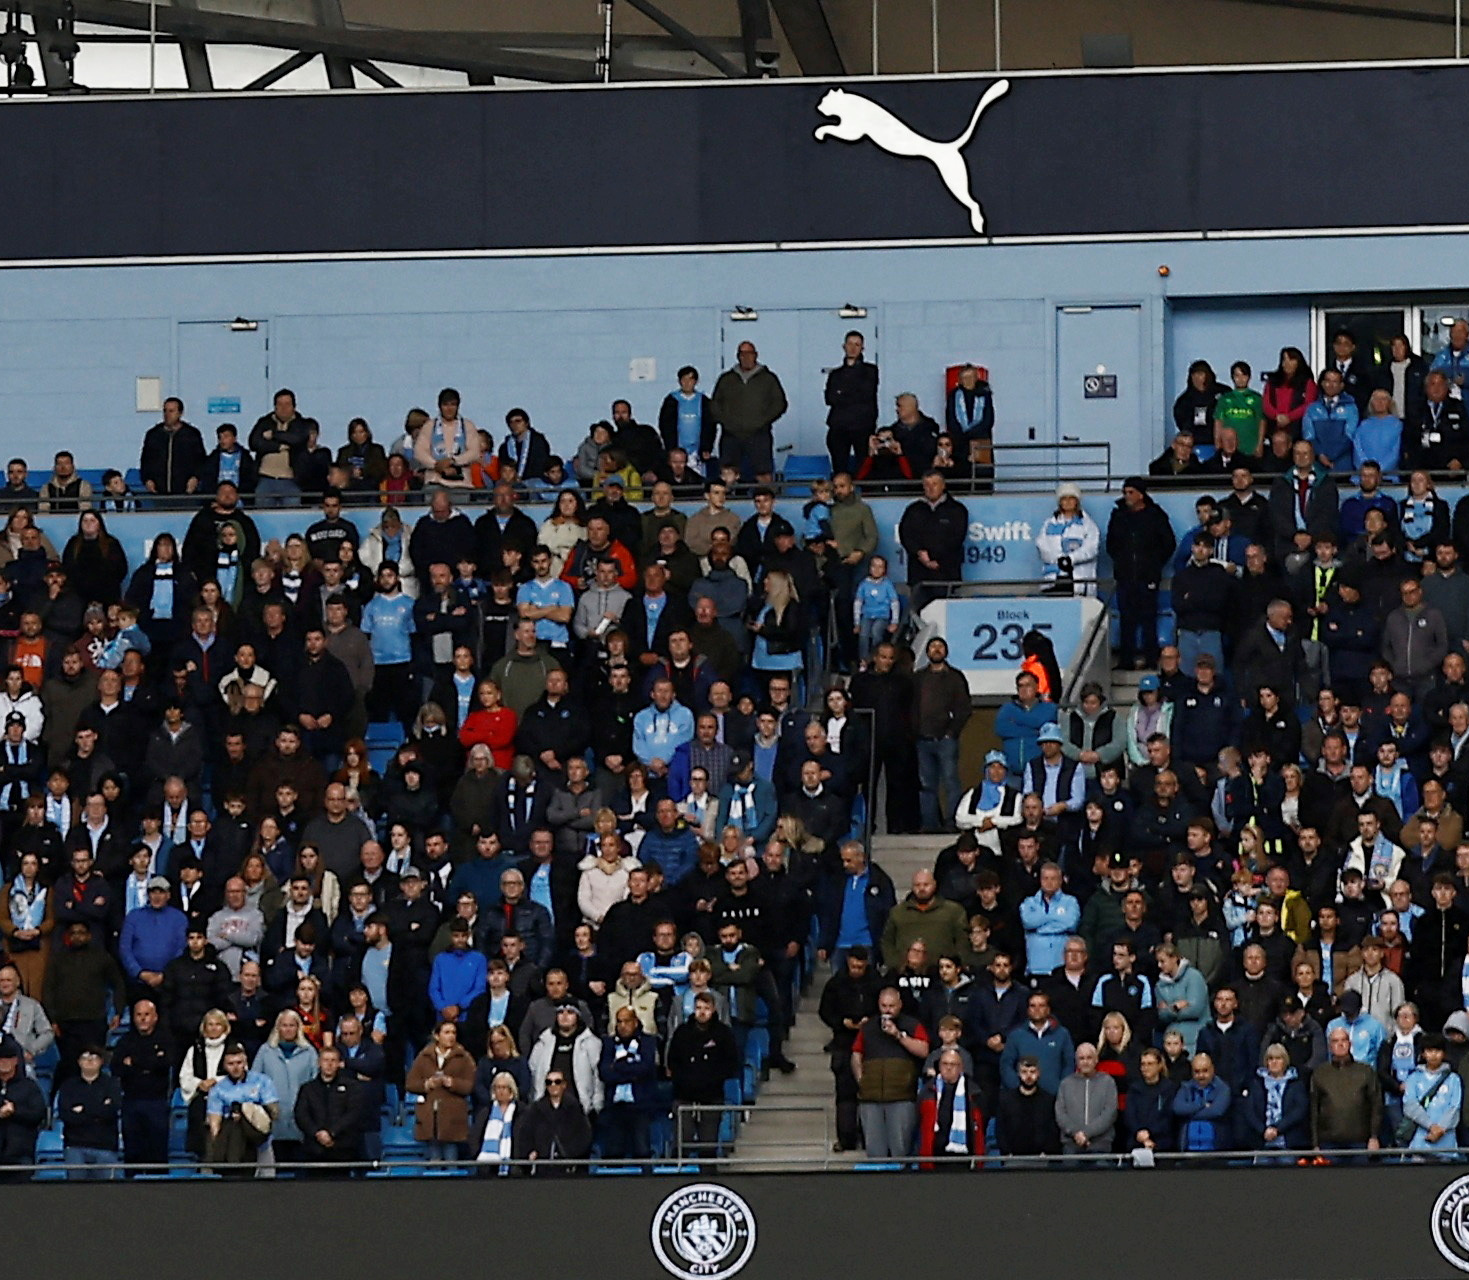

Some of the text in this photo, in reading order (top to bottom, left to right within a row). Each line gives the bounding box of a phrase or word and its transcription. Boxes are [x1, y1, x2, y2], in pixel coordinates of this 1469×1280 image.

[968, 520, 1031, 541] Swift
[997, 609, 1030, 620] Block
[665, 1192, 743, 1223] MANCHESTER
[689, 1264, 720, 1274] CITY
